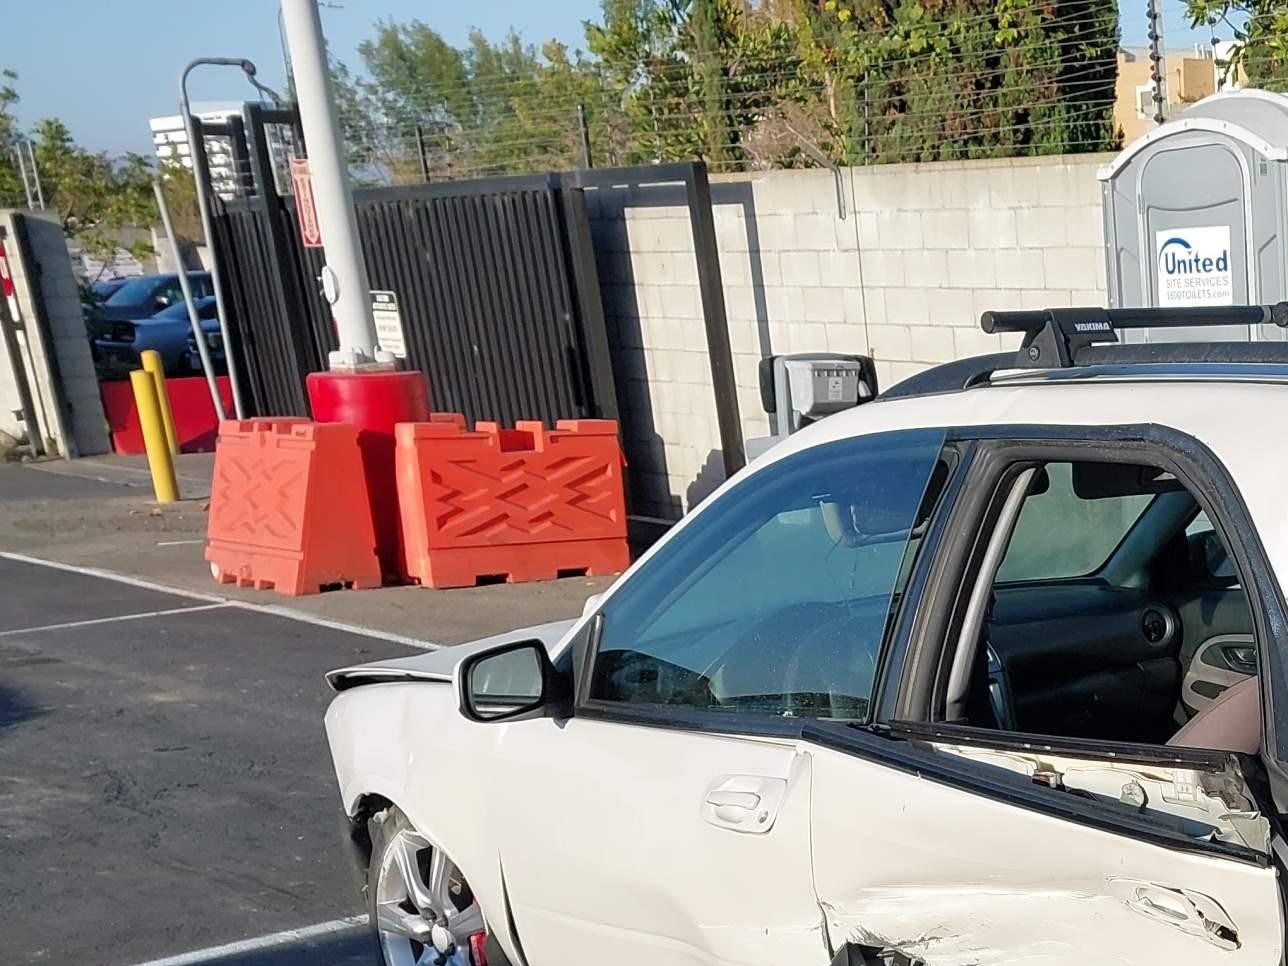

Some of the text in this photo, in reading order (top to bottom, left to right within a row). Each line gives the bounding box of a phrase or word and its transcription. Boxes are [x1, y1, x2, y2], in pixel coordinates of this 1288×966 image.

[1164, 249, 1228, 275] United
[1166, 276, 1230, 288] SITE SERVICES
